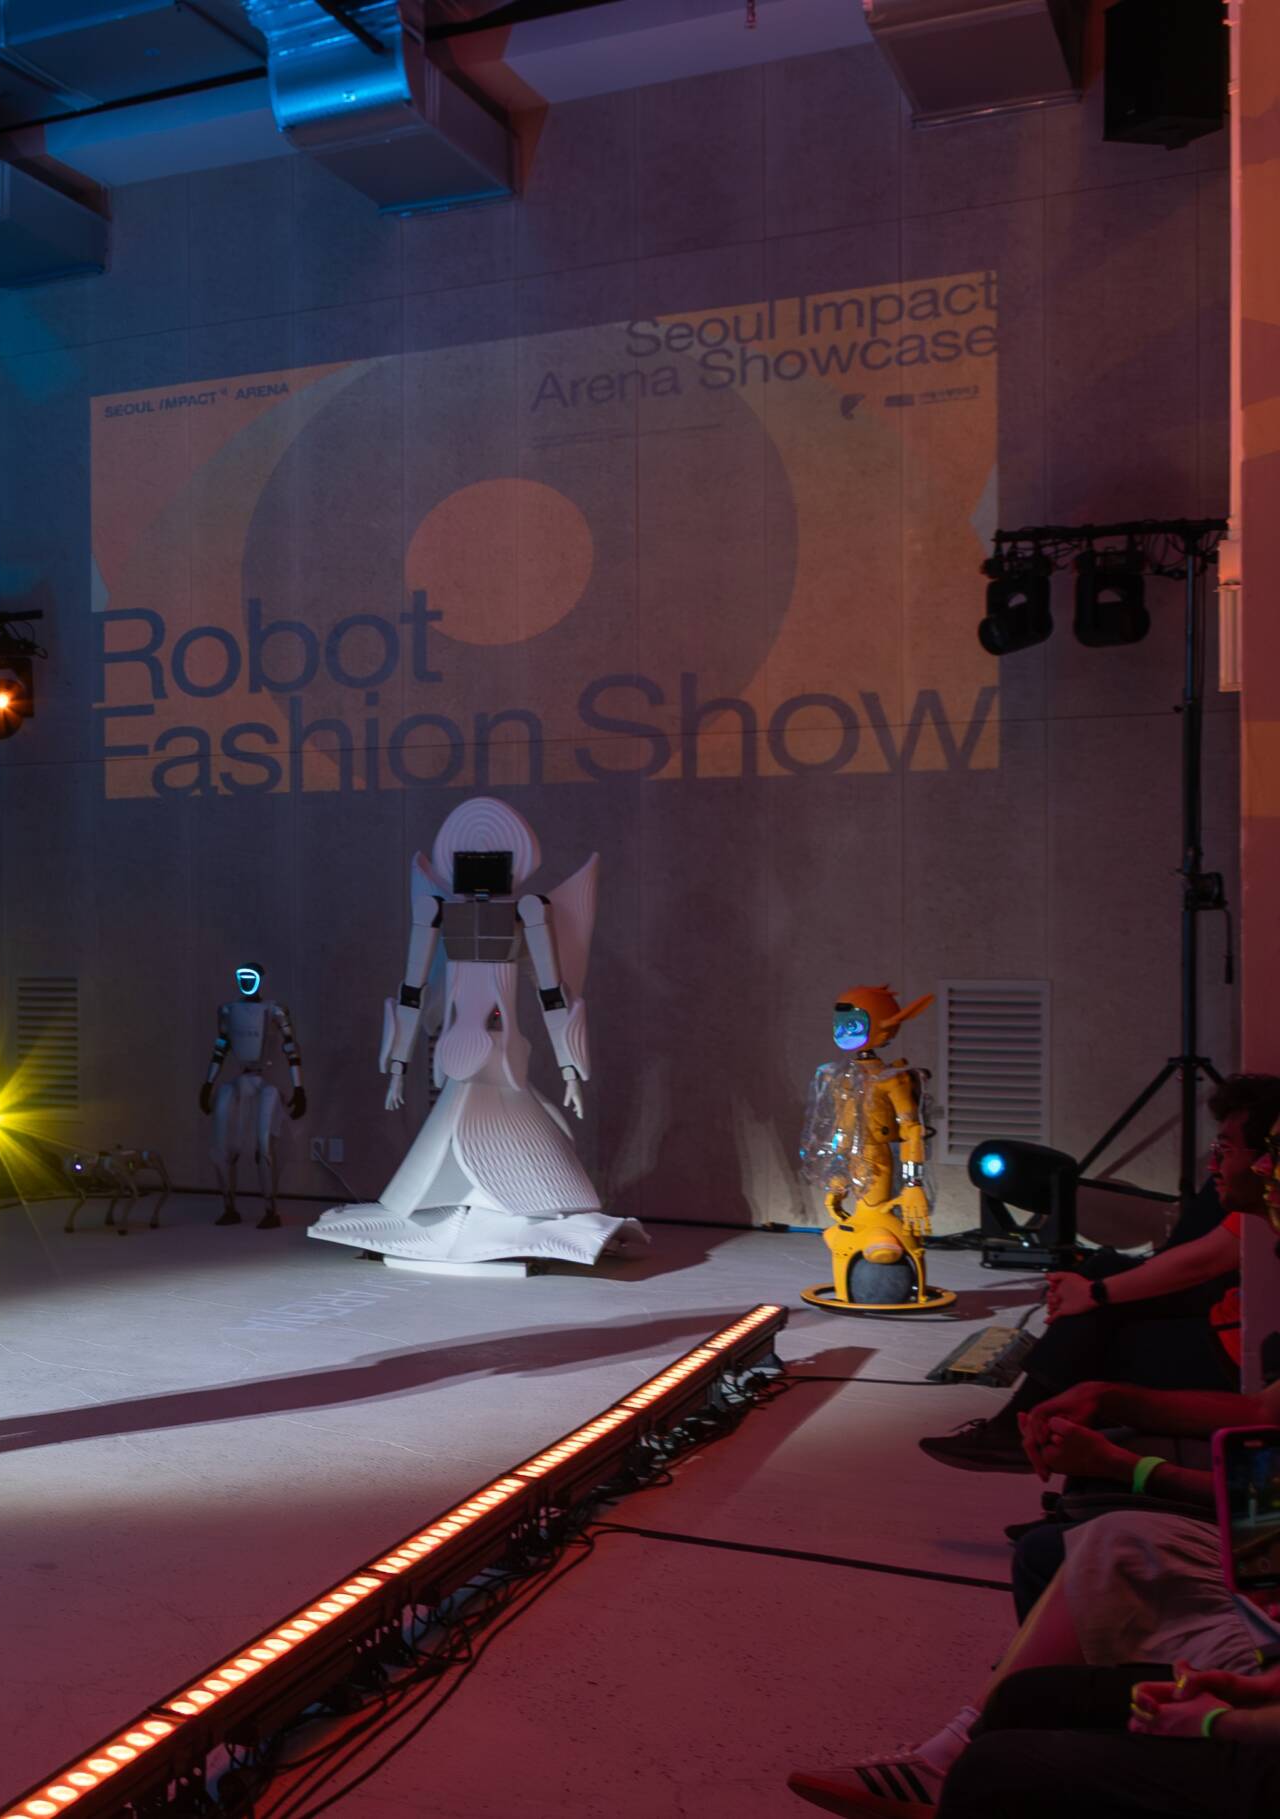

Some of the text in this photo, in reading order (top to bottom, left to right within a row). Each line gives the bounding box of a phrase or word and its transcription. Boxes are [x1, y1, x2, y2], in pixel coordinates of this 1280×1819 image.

[625, 271, 997, 357] Seoul Impact
[104, 402, 154, 418] SEOUL
[235, 382, 289, 400] ARENA
[530, 325, 998, 411] Arena Showcase
[93, 590, 442, 703] Robot
[94, 672, 999, 798] Fashion Show
